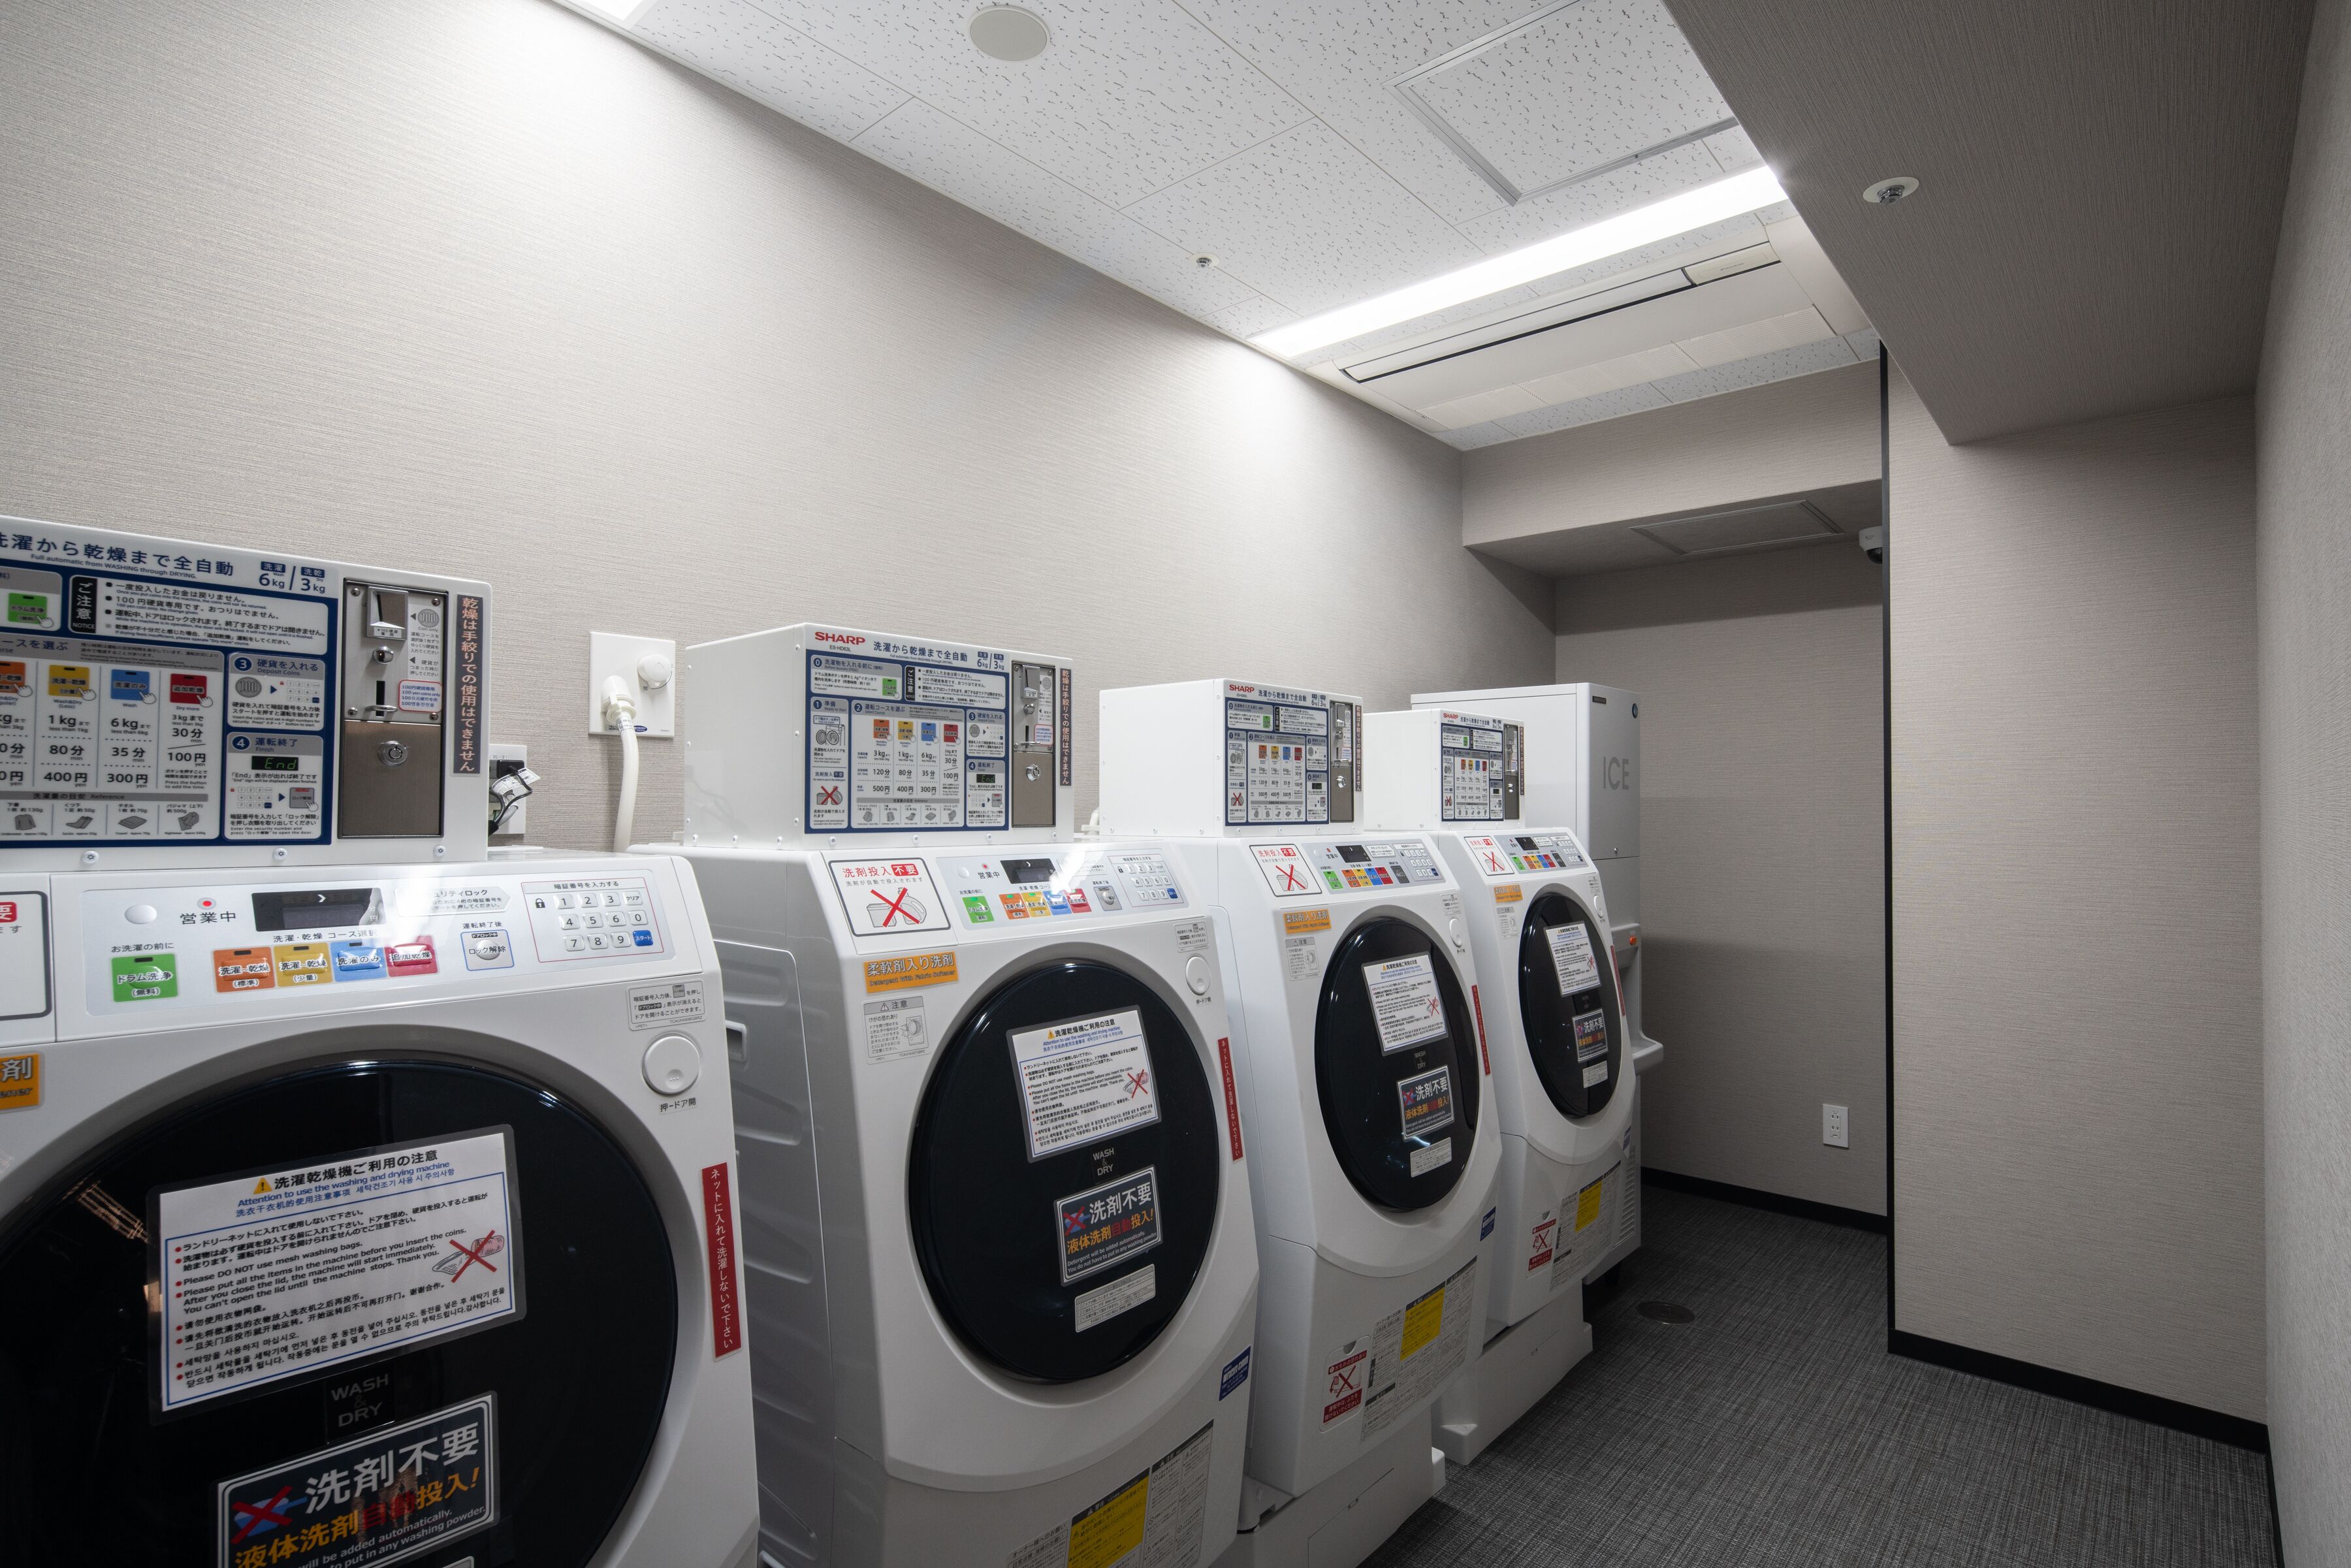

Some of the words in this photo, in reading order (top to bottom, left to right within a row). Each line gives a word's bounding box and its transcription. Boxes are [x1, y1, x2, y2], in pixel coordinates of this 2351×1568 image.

[46, 556, 82, 565] automatic
[104, 562, 138, 571] WASHING
[140, 567, 167, 576] through
[169, 570, 197, 579] DRYING.
[264, 563, 283, 571] 洗濯
[304, 568, 323, 577] 洗乾
[76, 582, 93, 620] ご注意
[72, 622, 95, 630] NOTICE
[815, 632, 865, 645] SHARP
[873, 641, 968, 662] 洗濯から乾燥まで全自動
[240, 659, 247, 668] 3
[257, 659, 318, 672] 硬貨を入れる
[460, 597, 479, 772] 乾燥は手絞りでの使用はできません
[1229, 684, 1255, 693] SHARP
[1258, 690, 1306, 701] 洗濯から乾燥まで全自動
[232, 707, 320, 719] スタートを押すと運転を始めます
[1061, 669, 1070, 784] 乾燥は手絞りでの使用はできません
[236, 739, 245, 747] 4
[255, 737, 297, 748] 運転終了
[264, 757, 296, 770] End
[1603, 756, 1629, 790] ICE
[33, 791, 86, 801] 洗濯量の目安
[554, 881, 619, 889] 暗証番号を入力する
[180, 910, 236, 925] 営業中
[110, 942, 174, 953] お洗濯の前に
[469, 946, 506, 955] ロック解除
[337, 956, 380, 965] 洗濯のみ
[867, 953, 953, 976] 柔軟剤入り洗剤
[117, 970, 172, 985] ドラム洗浄
[891, 1000, 908, 1009] 注意
[1054, 1018, 1115, 1037] 洗濯乾燥機ご利用の注意
[1, 1057, 31, 1081] 剤
[1221, 1040, 1241, 1157] ネットに入れて洗濯しないで下さい
[1416, 1076, 1448, 1101] 洗剤不要
[1093, 1147, 1115, 1160] WASH
[274, 1149, 438, 1190] 洗濯乾燥機ご利用の注意
[1097, 1164, 1113, 1176] DRY
[238, 1192, 281, 1208] Attention
[284, 1190, 293, 1198] to
[296, 1187, 312, 1196] use
[315, 1183, 329, 1192] the
[332, 1176, 368, 1191] washing
[370, 1173, 385, 1182] and
[388, 1167, 414, 1179] drying
[416, 1160, 449, 1173] machine
[356, 1179, 396, 1194] 세탁건조기
[398, 1176, 413, 1185] 사용
[415, 1174, 423, 1182] 시
[424, 1168, 455, 1180] 주의사항
[1089, 1180, 1151, 1225] 洗剤不要
[183, 1208, 363, 1252] ランドリーネットに入れて使用しないで下さい。
[710, 1168, 733, 1349] ネットに入れて洗濯しないで下さい
[1067, 1253, 1089, 1268] Detergent
[1106, 1241, 1118, 1251] added
[1119, 1229, 1145, 1245] automatically.
[184, 1272, 214, 1286] Please
[217, 1268, 231, 1278] DO
[234, 1263, 254, 1274] NOT
[257, 1260, 272, 1269] use
[276, 1253, 299, 1265] mesh
[303, 1245, 338, 1260] washing
[340, 1239, 362, 1252] bags.
[331, 1374, 389, 1401] WASH
[338, 1403, 384, 1428] DRY
[305, 1422, 479, 1514] 洗剤不要
[299, 1556, 319, 1568] will
[323, 1552, 337, 1565] be
[340, 1539, 376, 1559] added
[379, 1509, 453, 1545] automatically.
[345, 1554, 364, 1568] put
[366, 1548, 376, 1560] in
[379, 1539, 398, 1557] any
[401, 1524, 445, 1548] washing
[447, 1507, 486, 1529] powder.
